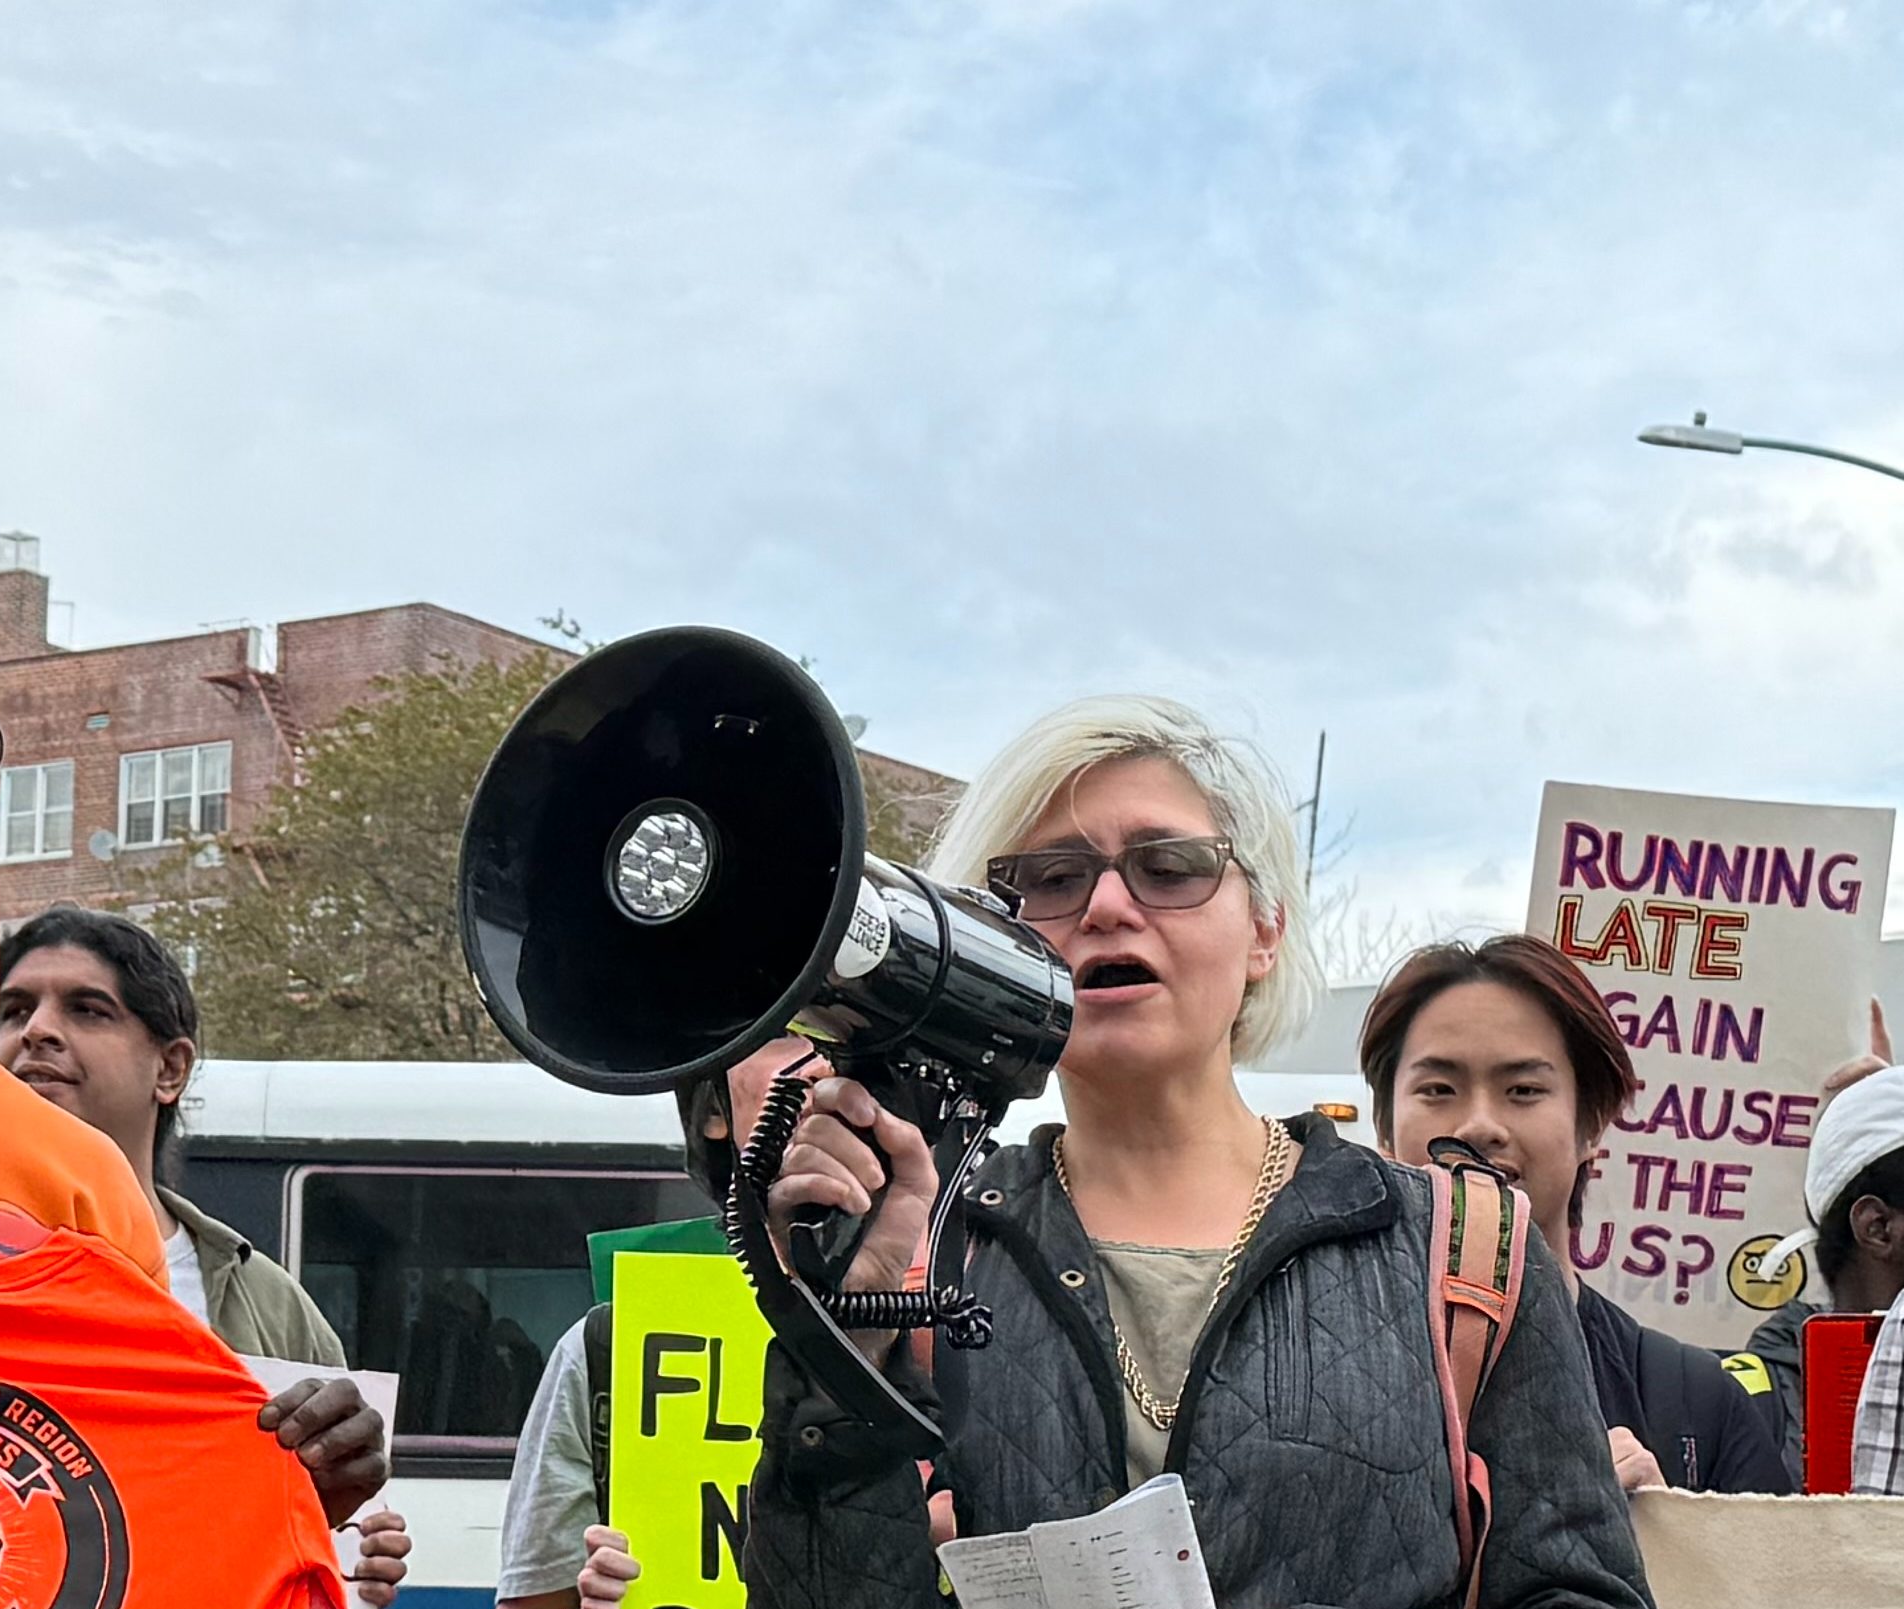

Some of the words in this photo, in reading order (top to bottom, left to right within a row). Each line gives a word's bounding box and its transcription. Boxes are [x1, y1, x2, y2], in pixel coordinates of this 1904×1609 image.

[1558, 821, 1862, 914] RUNNING
[1552, 895, 1749, 981] LATE
[1626, 1152, 1753, 1221] THE
[4, 1397, 94, 1480] REGION
